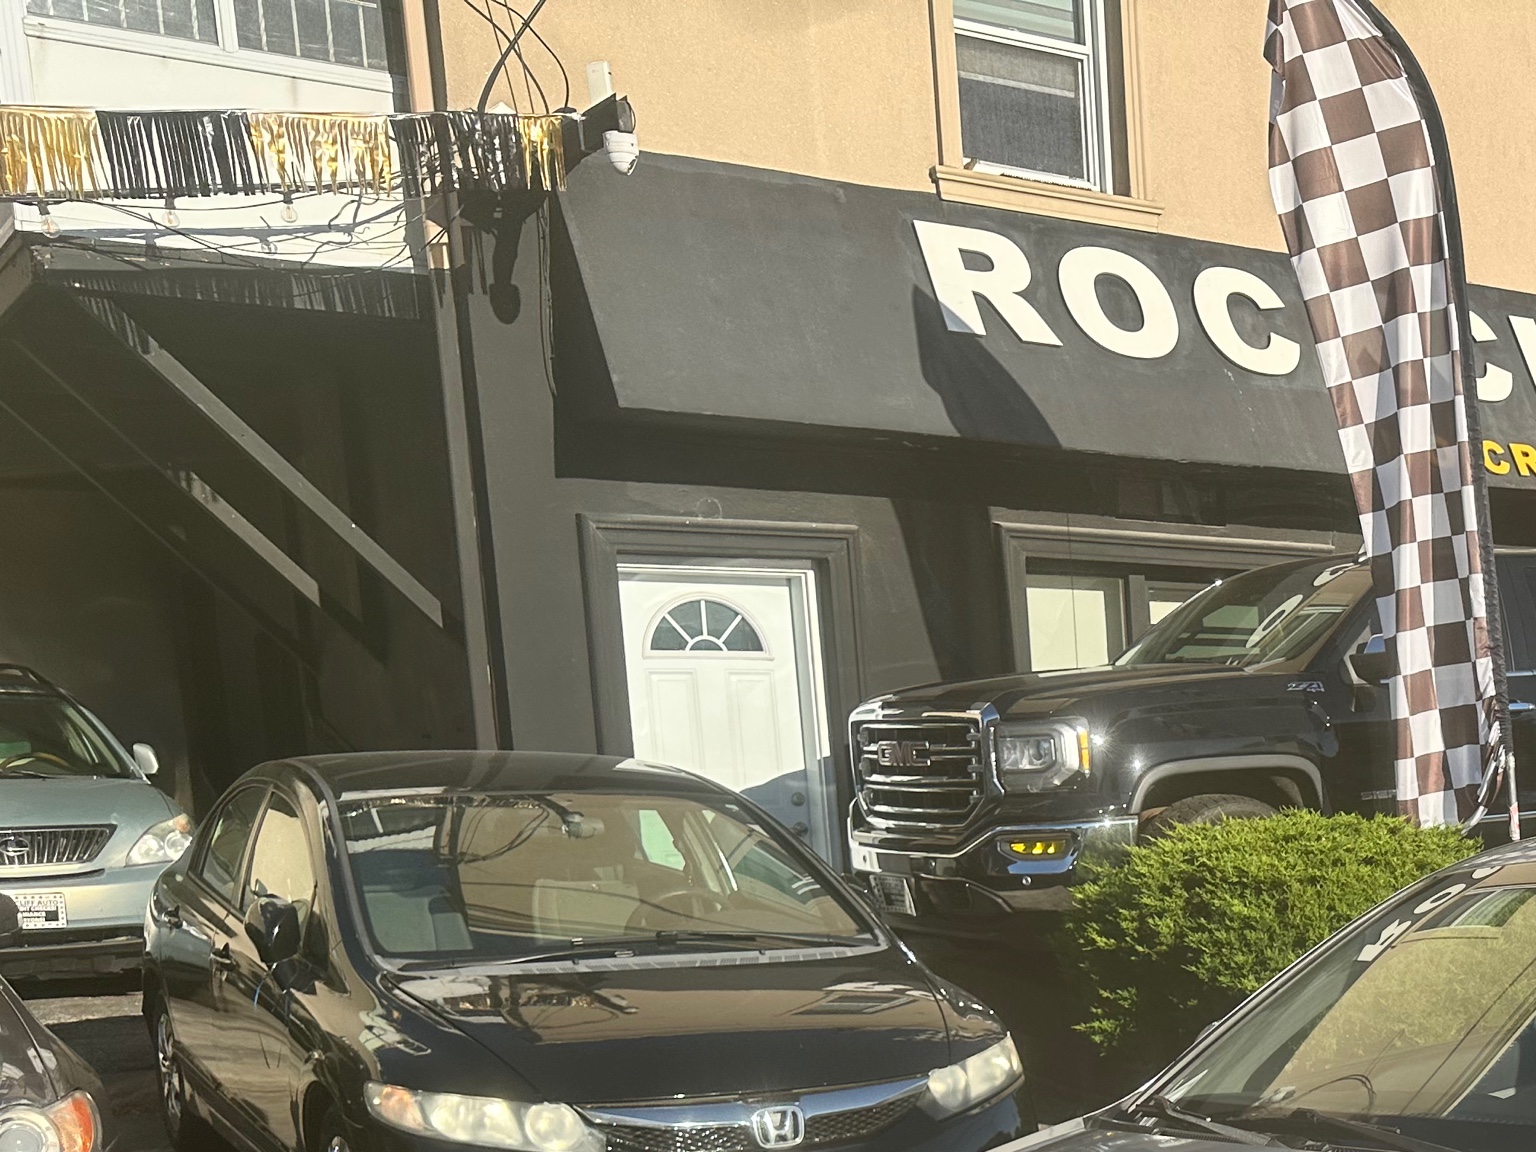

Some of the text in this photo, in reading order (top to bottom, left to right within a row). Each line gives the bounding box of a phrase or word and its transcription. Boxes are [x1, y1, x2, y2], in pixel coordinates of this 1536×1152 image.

[913, 220, 1301, 376] ROC
[877, 740, 931, 767] GMC
[1360, 789, 1397, 801] SIER
